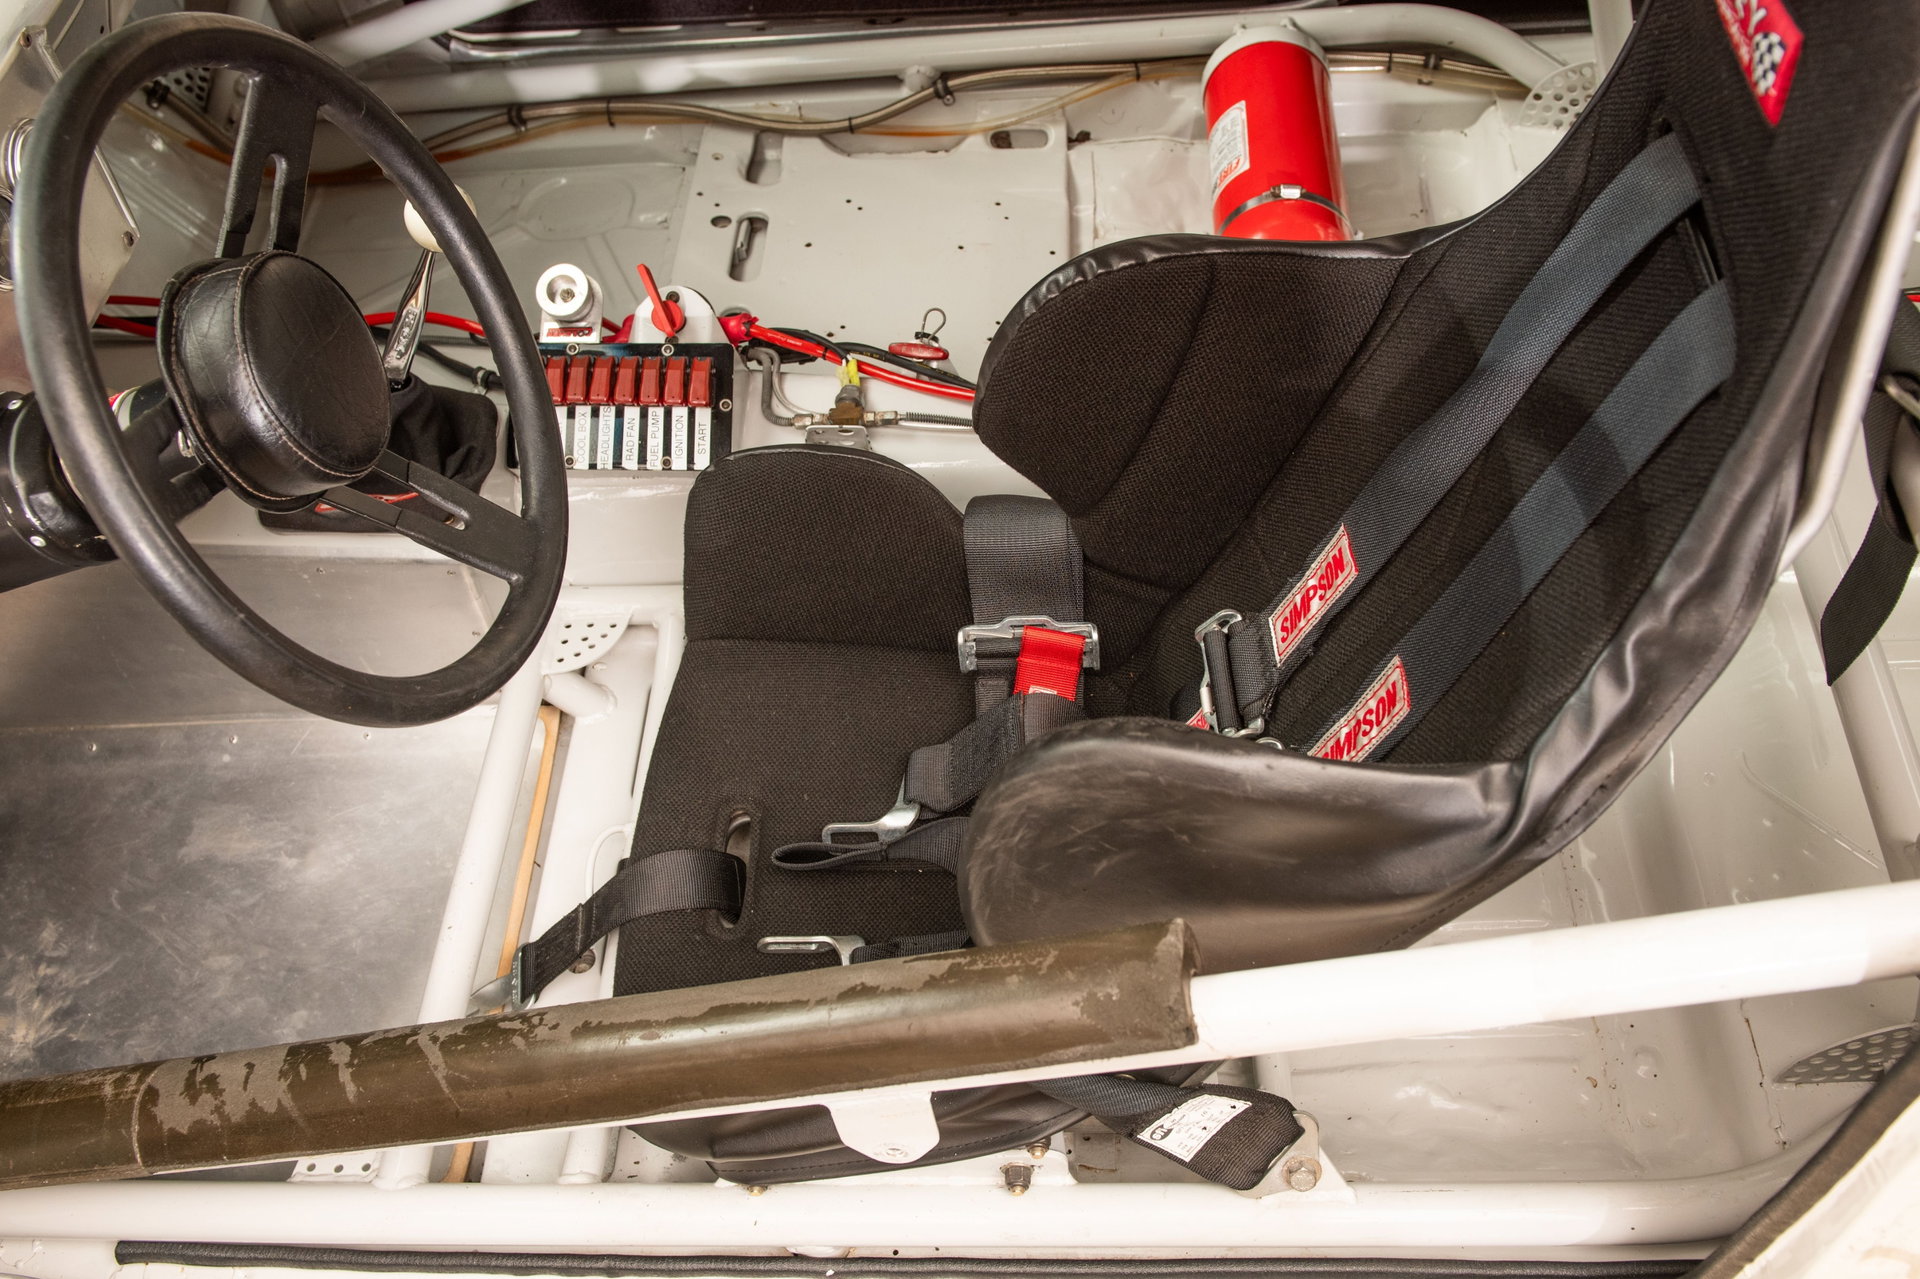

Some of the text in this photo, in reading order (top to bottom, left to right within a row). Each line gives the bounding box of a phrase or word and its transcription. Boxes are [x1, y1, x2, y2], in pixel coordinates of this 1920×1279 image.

[576, 411, 588, 464] COOL BOX
[599, 406, 612, 470] HEADLIGHTS
[624, 417, 636, 461] RAD FAN
[649, 410, 661, 468] FUEL PUMP
[674, 415, 685, 459] IGNITION
[697, 422, 708, 455] START
[1280, 547, 1345, 644] SIMPSON
